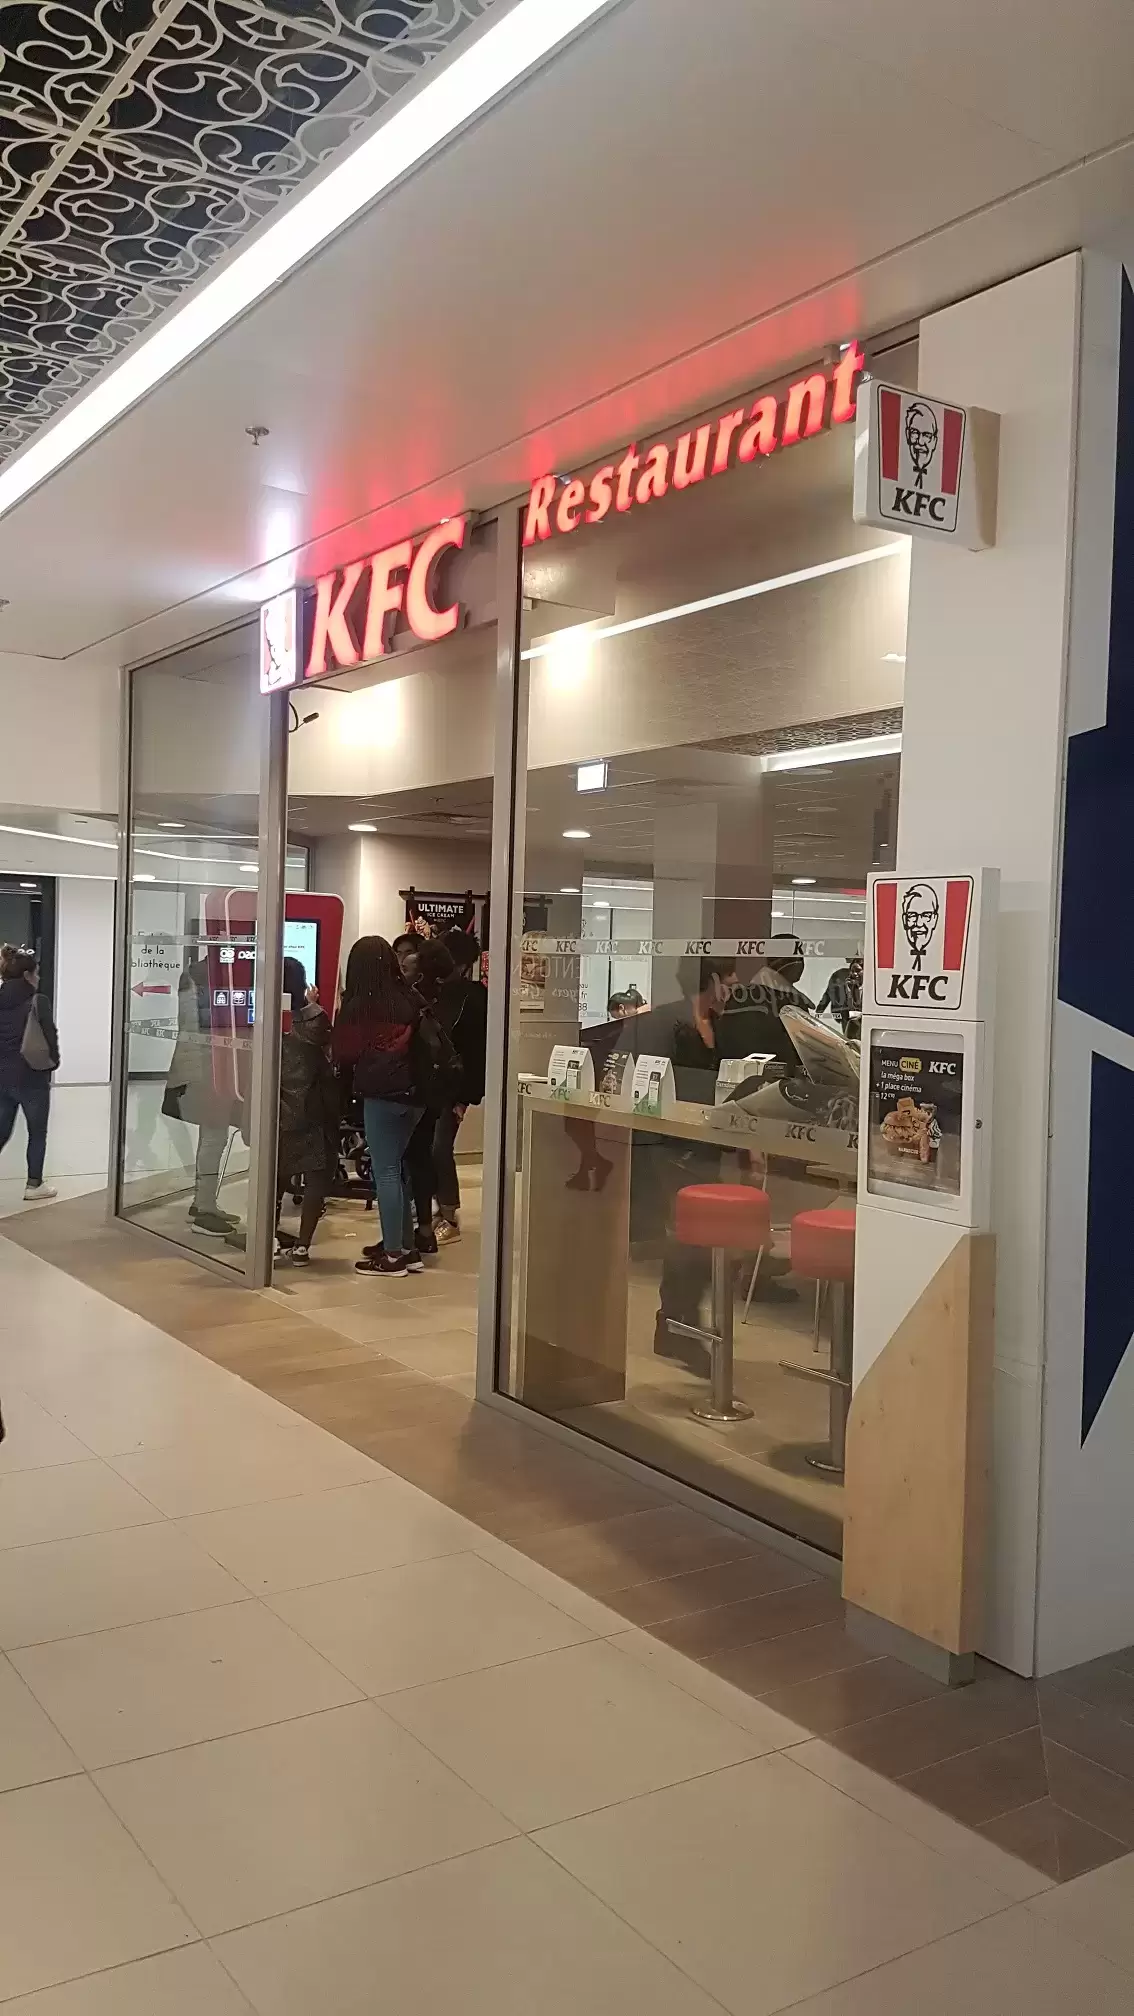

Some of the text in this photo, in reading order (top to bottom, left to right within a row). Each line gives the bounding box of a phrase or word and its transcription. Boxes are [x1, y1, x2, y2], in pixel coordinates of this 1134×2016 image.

[522, 339, 865, 548] Restaurant
[891, 486, 947, 522] KFC
[304, 517, 466, 678] KFC
[418, 903, 464, 914] ULTIMATE
[141, 945, 165, 955] de la
[556, 941, 577, 952] KFC
[595, 941, 619, 954] KFC
[638, 941, 663, 954] KFC
[685, 941, 712, 955] KFC
[736, 941, 766, 955] KFC
[793, 940, 825, 956] KFC
[887, 974, 949, 1001] KFC
[881, 1059, 919, 1069] MENU CINÉ
[928, 1061, 957, 1075] KFC
[887, 1072, 903, 1082] méga
[904, 1073, 915, 1082] box
[885, 1082, 900, 1091] place
[900, 1083, 922, 1093] cinéma
[589, 1091, 611, 1108] KFC
[785, 1124, 816, 1142] KFC
